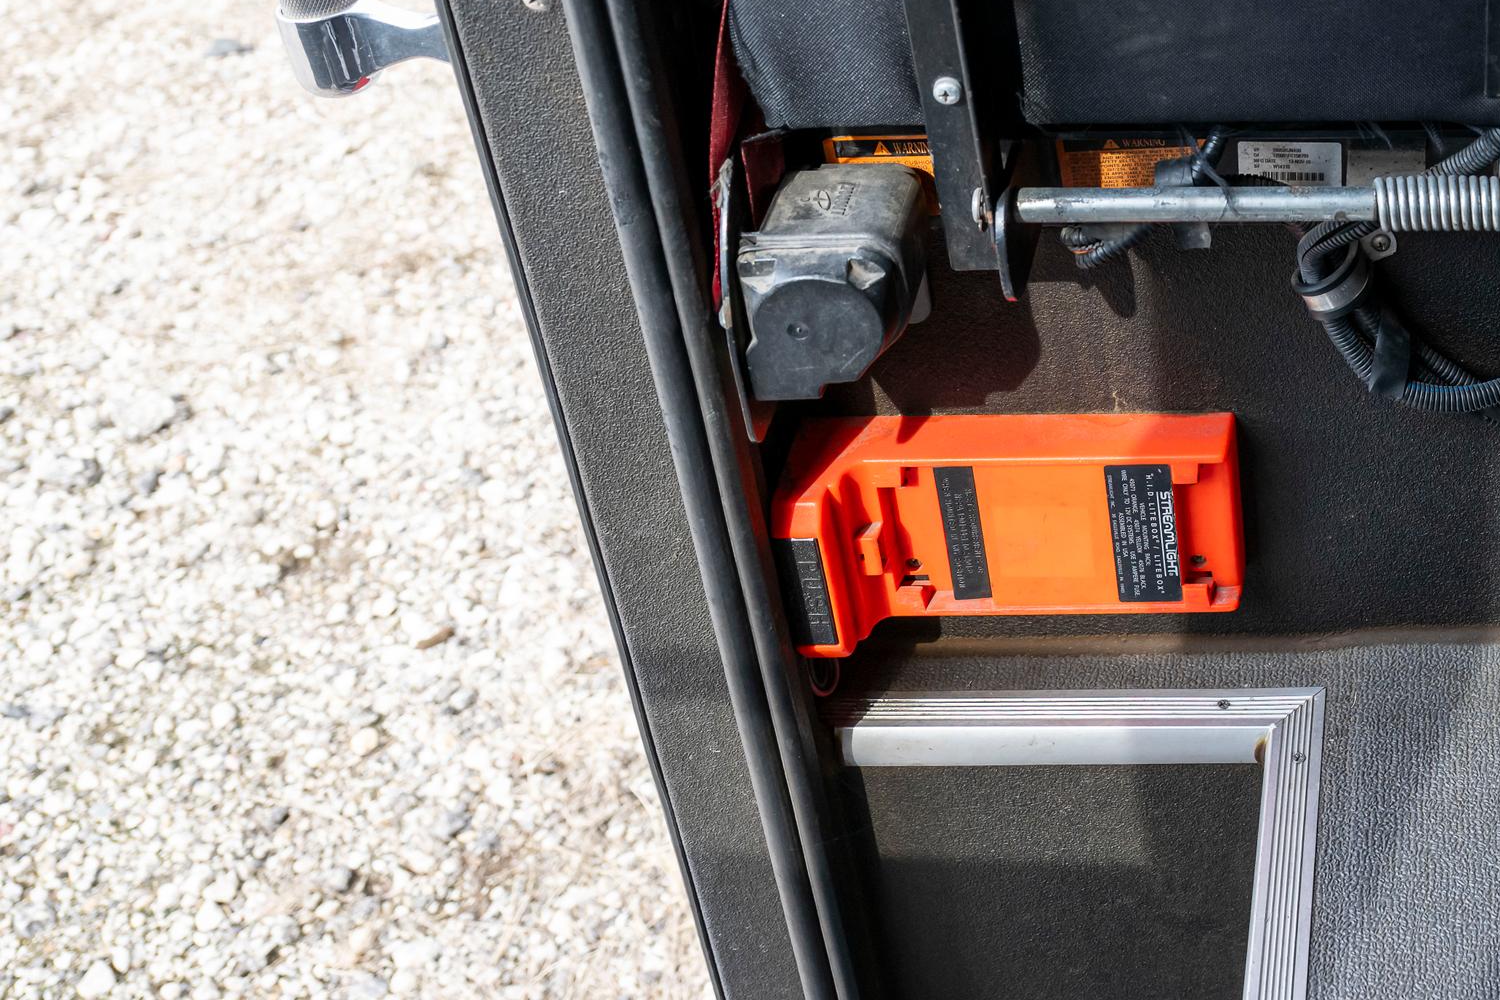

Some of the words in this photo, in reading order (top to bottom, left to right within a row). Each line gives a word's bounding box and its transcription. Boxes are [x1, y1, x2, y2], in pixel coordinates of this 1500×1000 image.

[893, 142, 930, 154] WARNIN
[1138, 502, 1146, 520] VEHICLE
[1118, 512, 1126, 538] ASSEMBLED
[1141, 525, 1149, 549] MOUNTING
